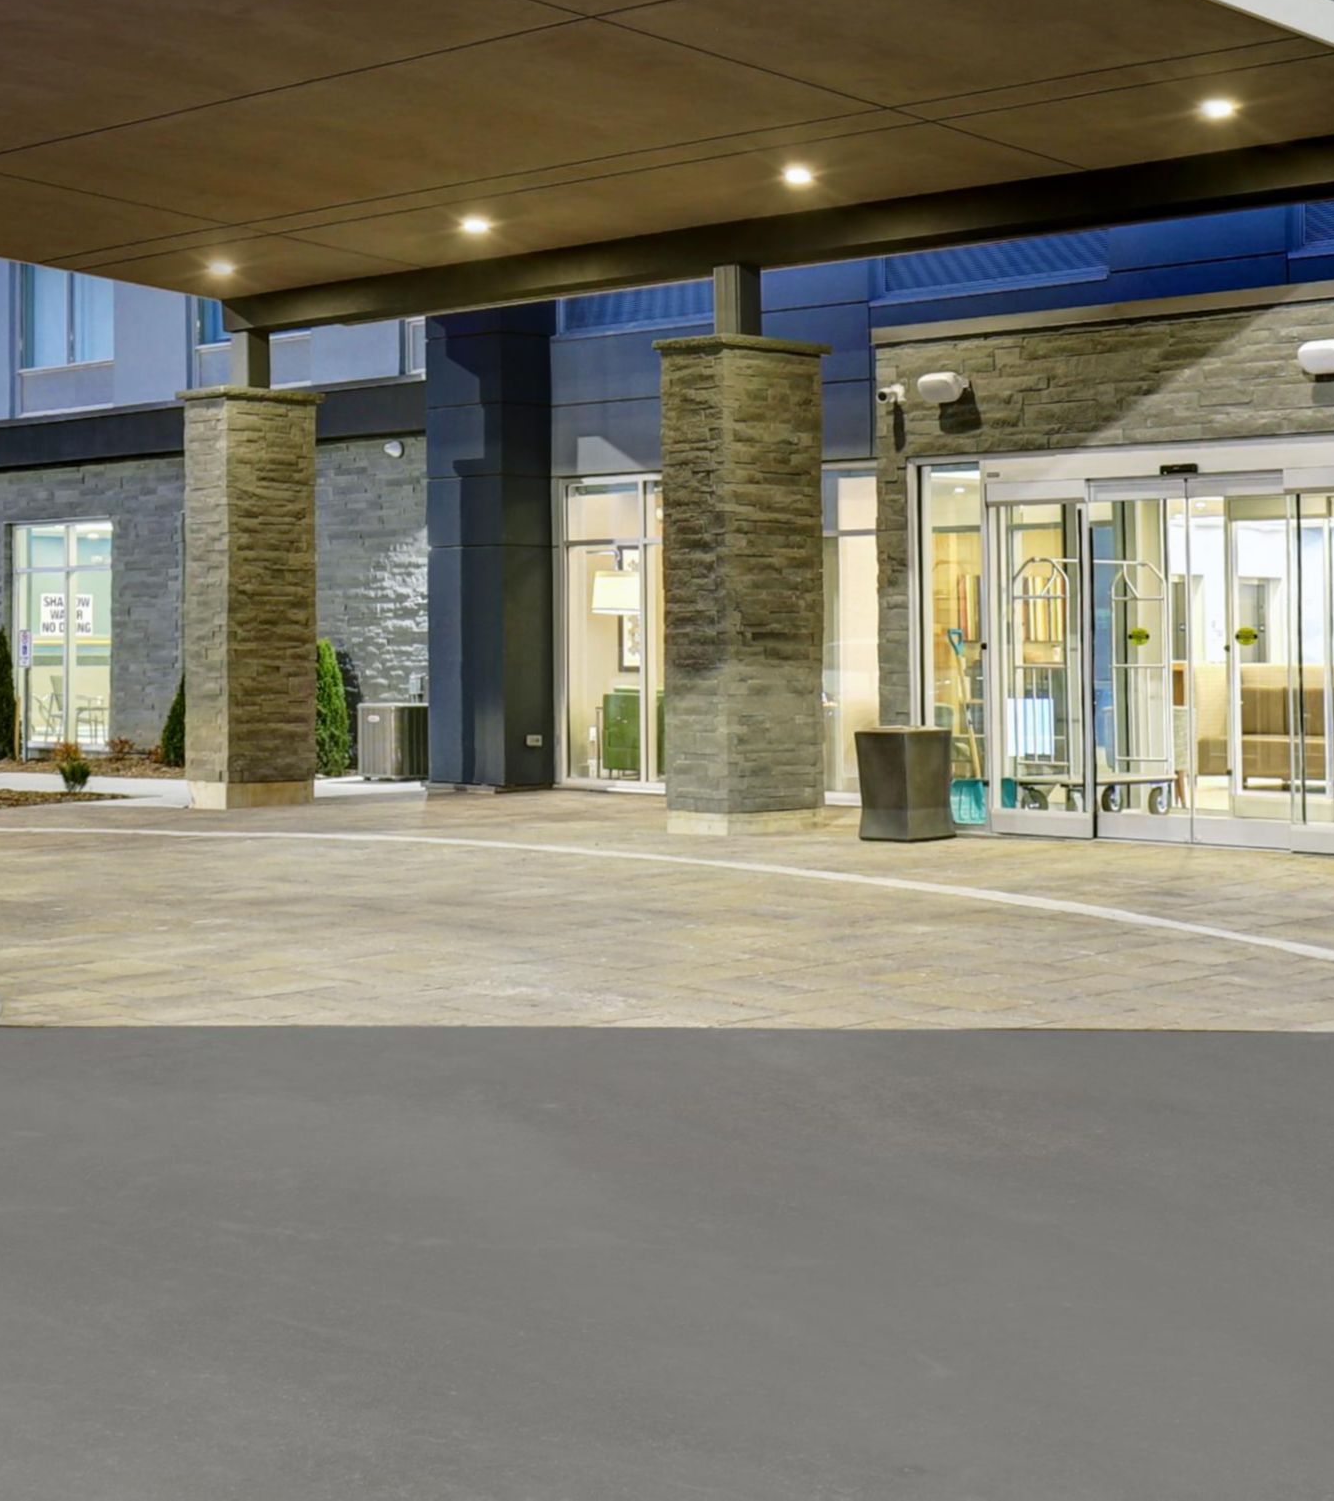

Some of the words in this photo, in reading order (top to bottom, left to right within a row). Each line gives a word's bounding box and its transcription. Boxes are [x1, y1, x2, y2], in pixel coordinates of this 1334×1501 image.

[42, 595, 91, 608] SHAOW
[50, 608, 83, 620] WAR
[42, 621, 56, 633] NO
